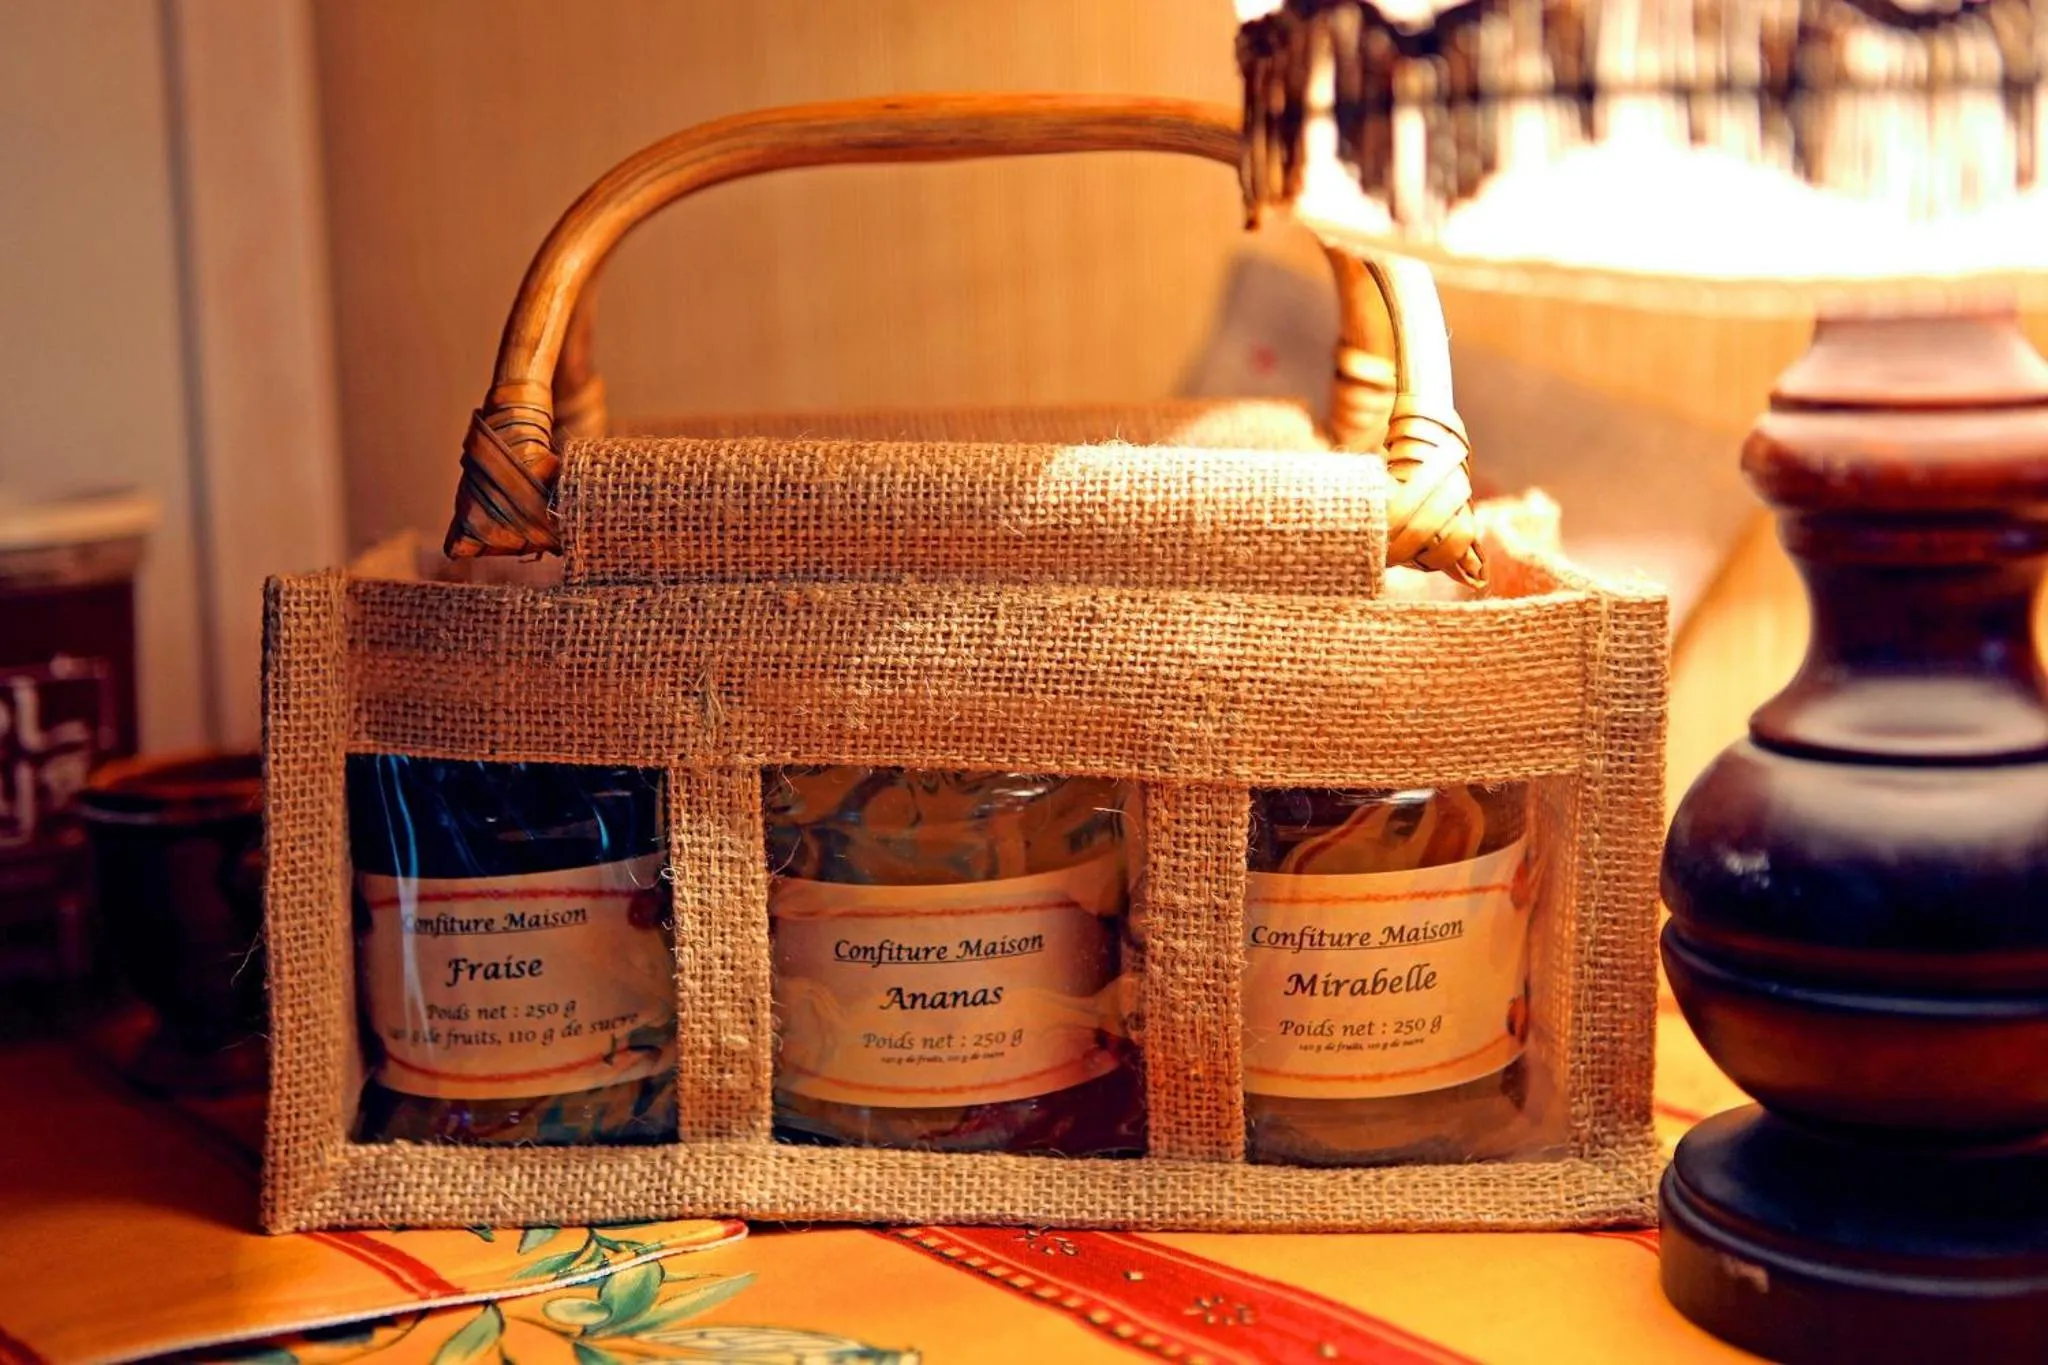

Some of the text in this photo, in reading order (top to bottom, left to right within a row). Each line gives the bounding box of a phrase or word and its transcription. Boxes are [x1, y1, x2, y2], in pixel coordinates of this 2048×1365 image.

[502, 907, 588, 932] Maison
[1251, 918, 1465, 953] Confiture Maison
[833, 933, 1045, 968] Confiture Maison
[445, 954, 543, 987] Fraise
[1283, 962, 1438, 997] Mirabelle
[427, 1003, 470, 1021] Poids
[477, 1005, 508, 1020] net
[524, 1002, 559, 1019] 250
[564, 1000, 577, 1018] g
[879, 986, 1004, 1011] Ananas
[561, 1018, 583, 1038] de
[1279, 1018, 1335, 1037] Poids
[1342, 1020, 1375, 1037] net
[1393, 1017, 1426, 1035] 250
[1430, 1014, 1443, 1034] g
[863, 1031, 915, 1050] Poids
[922, 1033, 954, 1049] net
[973, 1031, 1006, 1048] 250
[1010, 1028, 1024, 1048] g
